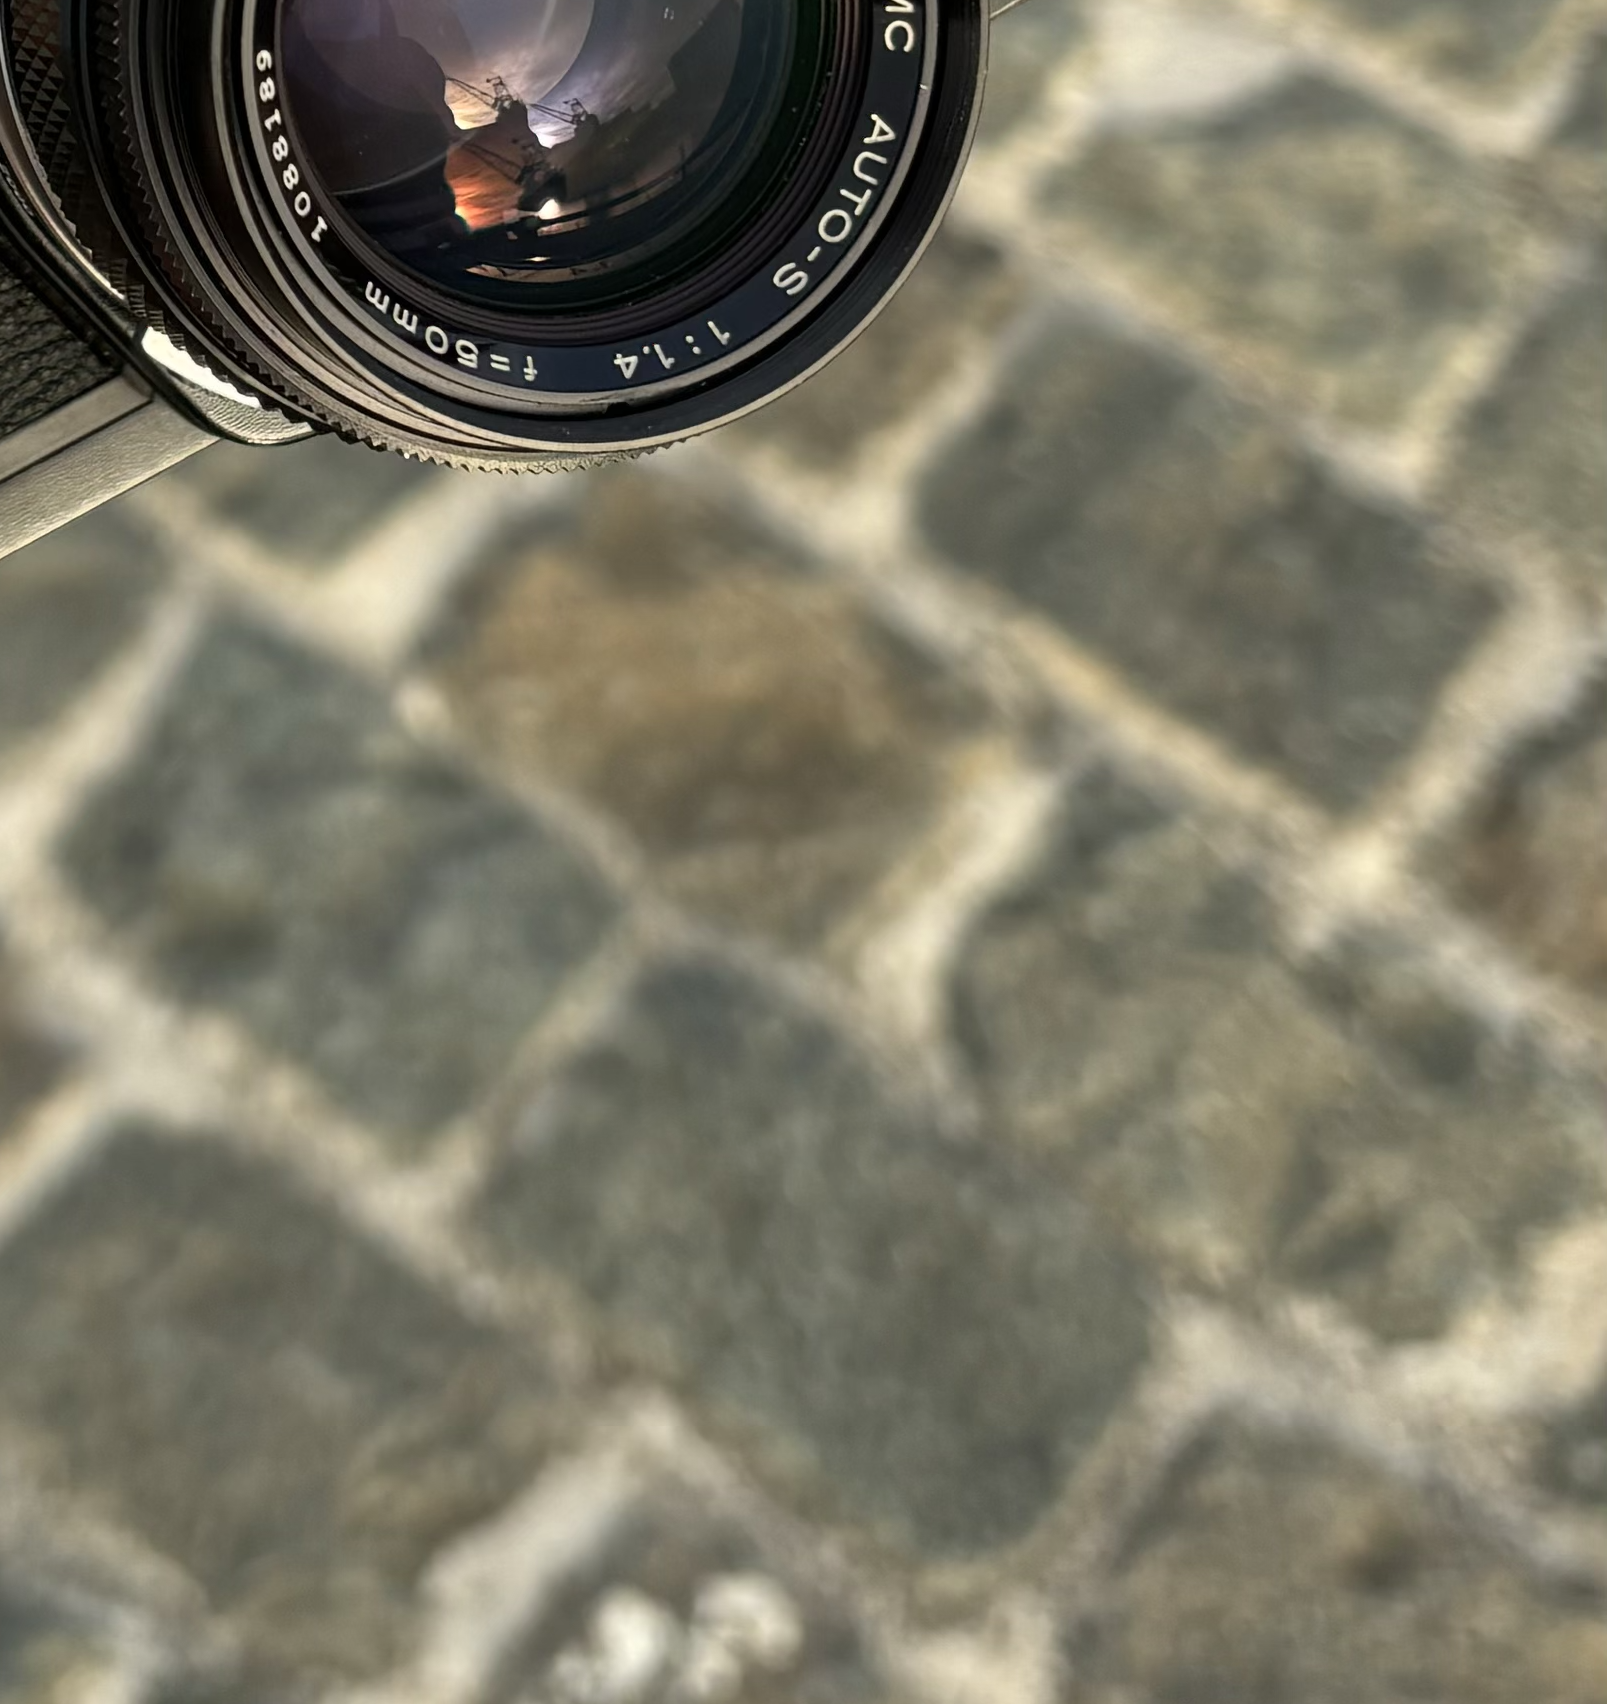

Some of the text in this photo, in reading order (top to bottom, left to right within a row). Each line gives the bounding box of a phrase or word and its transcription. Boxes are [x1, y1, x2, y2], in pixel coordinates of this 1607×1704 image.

[255, 49, 328, 243] 1088189
[773, 113, 897, 296] AUTO-S
[365, 281, 539, 382] f=50mm
[613, 320, 731, 380] 1:1.4
